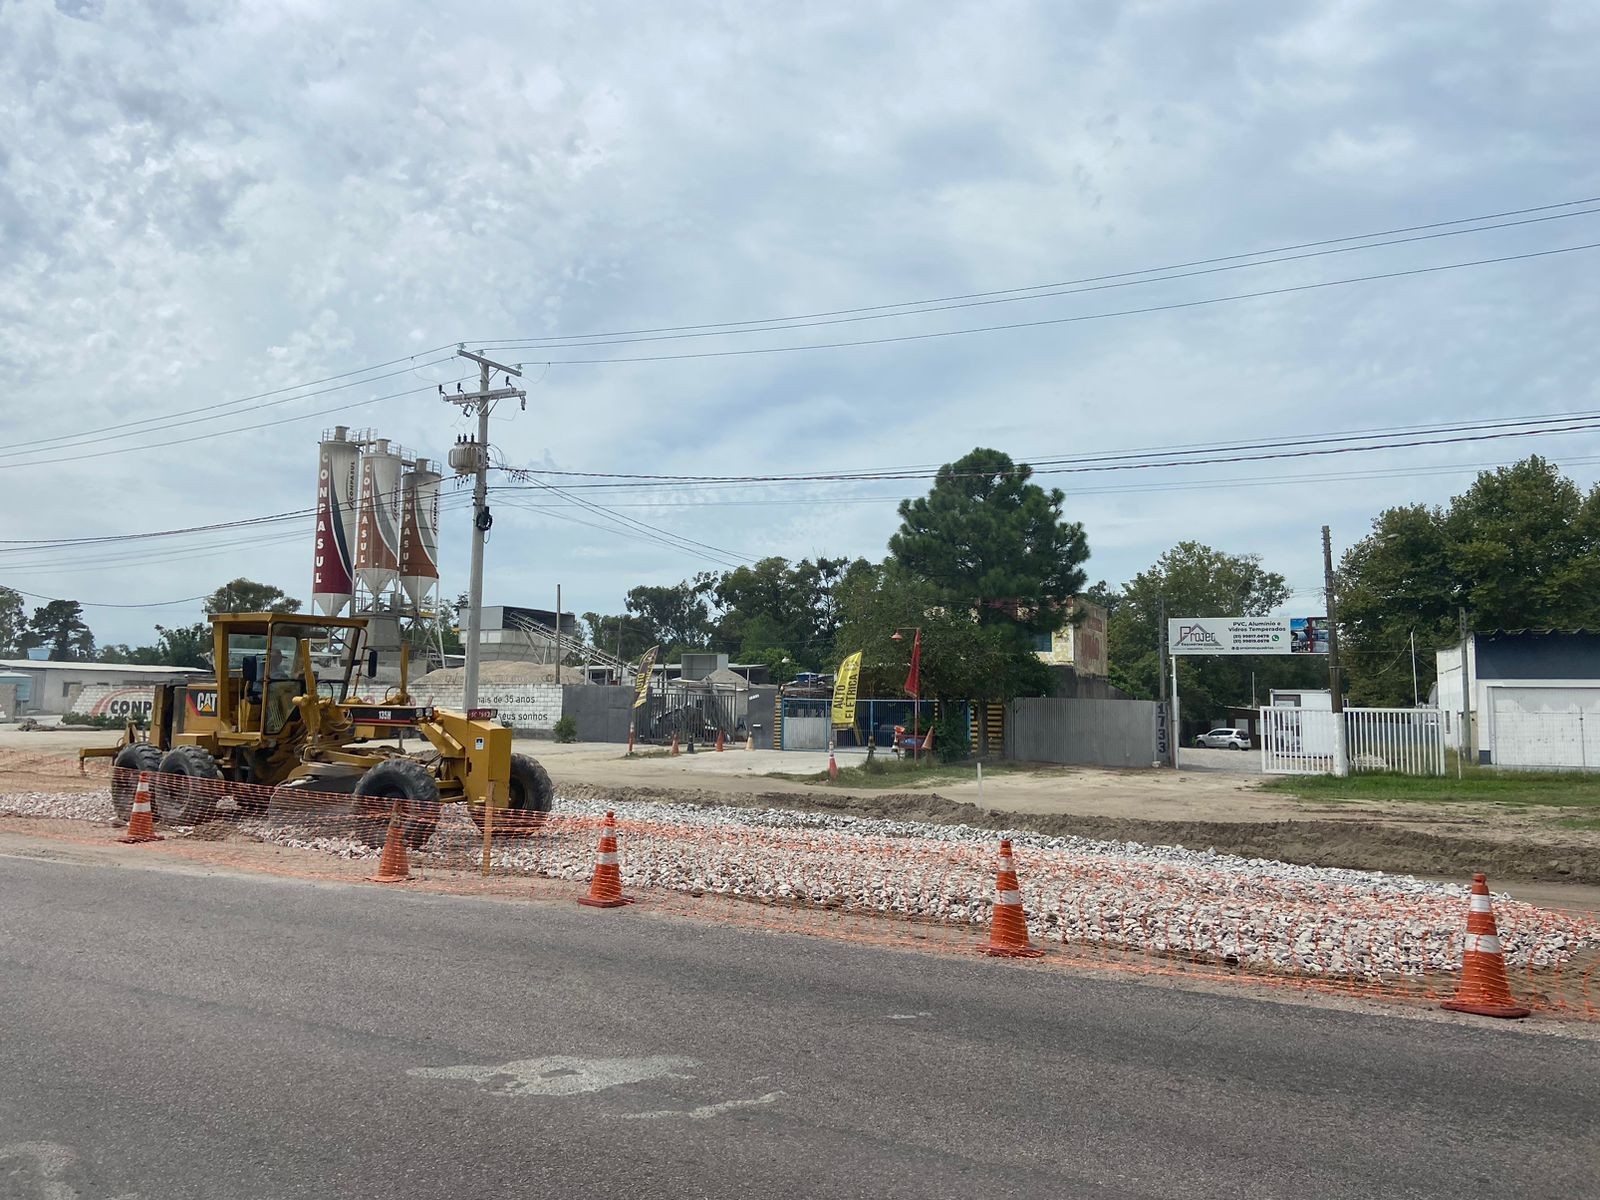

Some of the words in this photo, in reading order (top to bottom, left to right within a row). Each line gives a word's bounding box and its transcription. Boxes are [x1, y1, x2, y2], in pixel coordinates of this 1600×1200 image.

[315, 452, 329, 584] CONPASUL
[360, 464, 371, 563] CONPASUL
[402, 490, 413, 573] ONPASUL
[196, 692, 217, 711] CAT
[493, 695, 503, 704] de
[504, 694, 514, 704] 35
[515, 695, 535, 704] anos
[518, 712, 548, 721] sonhos
[833, 684, 846, 710] AUTO
[1157, 702, 1166, 754] 1733
